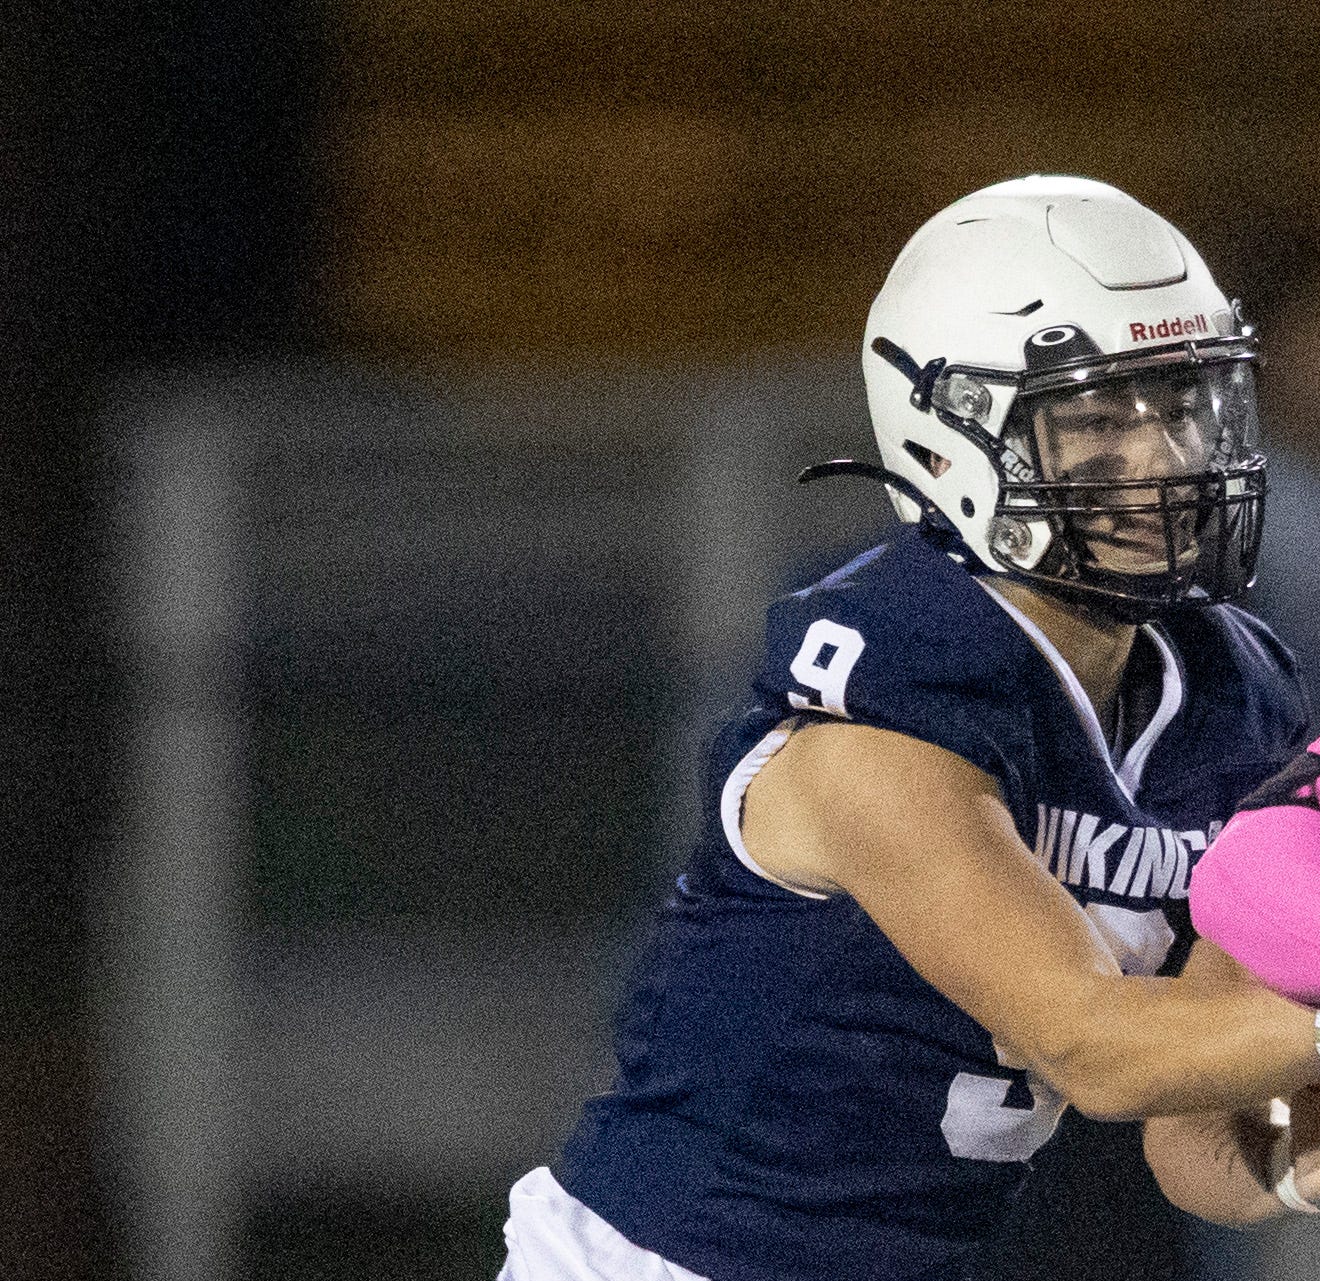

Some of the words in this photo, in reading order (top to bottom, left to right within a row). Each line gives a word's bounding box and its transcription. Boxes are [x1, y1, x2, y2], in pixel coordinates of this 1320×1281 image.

[1129, 313, 1208, 342] Riddell
[787, 619, 866, 719] 9
[1032, 803, 1223, 899] VIKING
